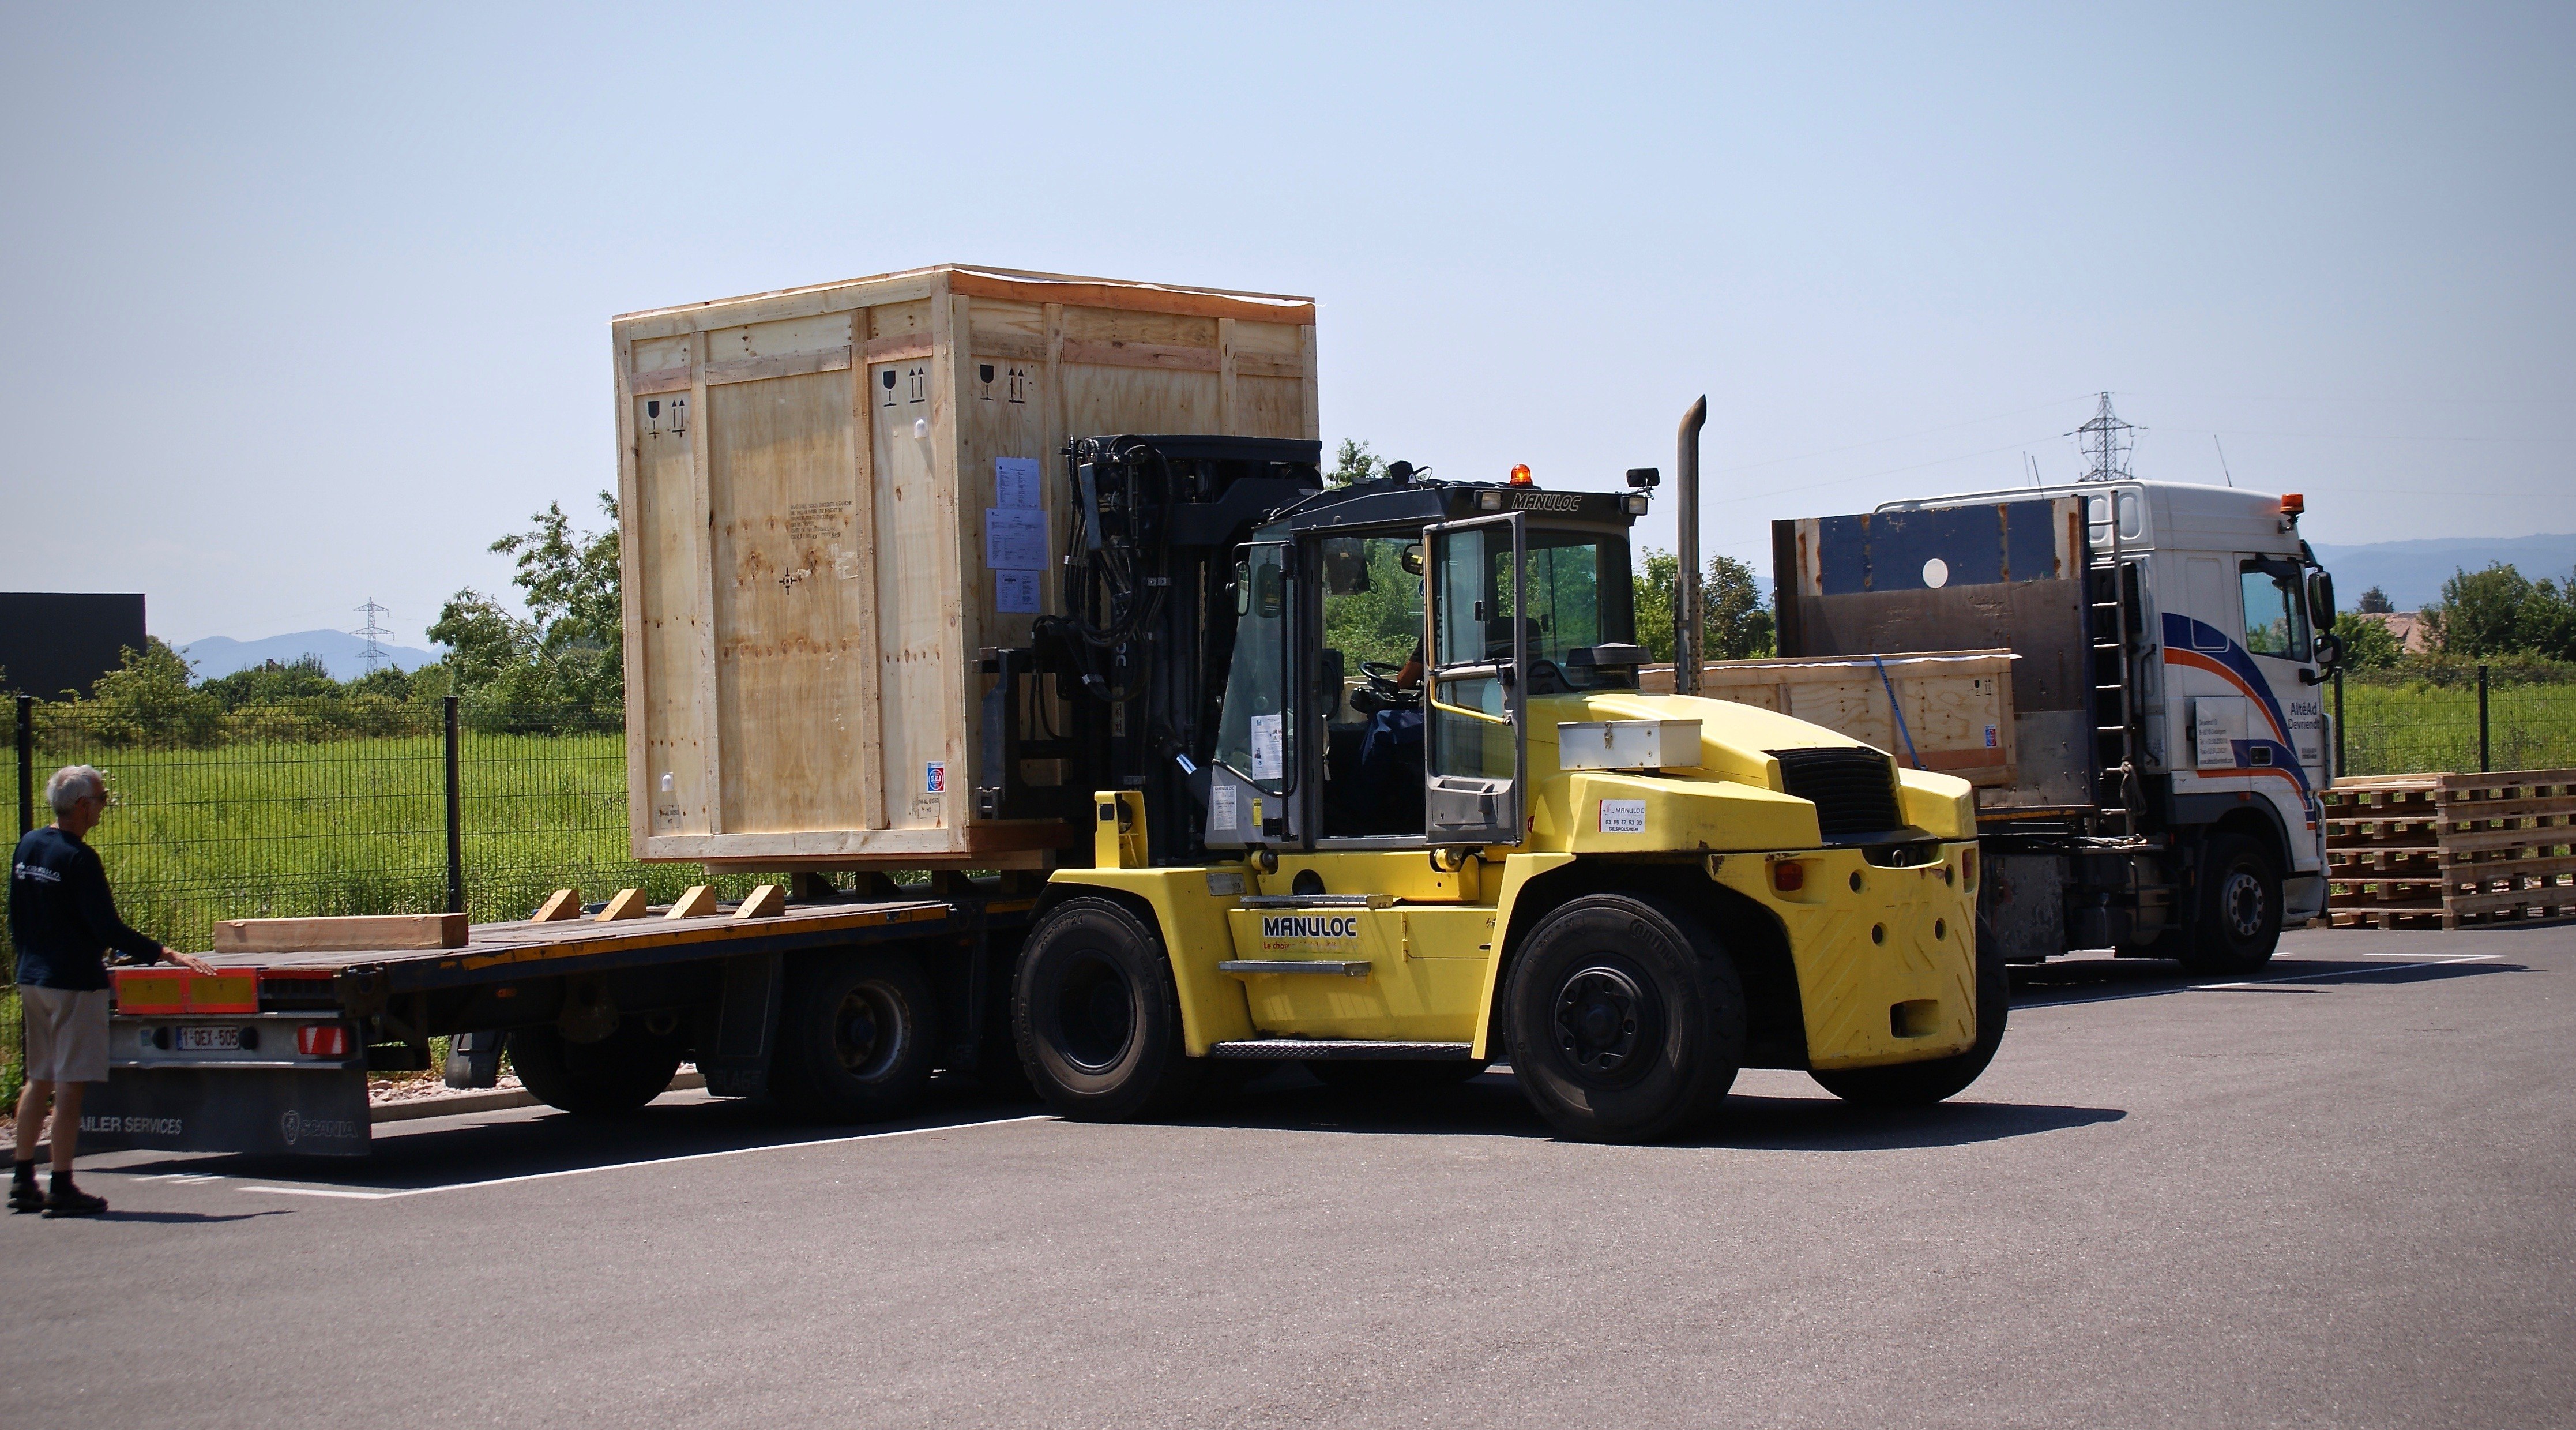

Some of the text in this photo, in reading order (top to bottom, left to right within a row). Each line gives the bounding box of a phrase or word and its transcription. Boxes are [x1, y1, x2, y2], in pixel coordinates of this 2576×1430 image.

[1511, 493, 1582, 512] MANULOC
[2291, 701, 2317, 715] AltéAd
[1263, 916, 1357, 937] MANULOC
[1263, 941, 1271, 949] Le
[80, 1116, 183, 1135] AILER SERVICES
[300, 1119, 358, 1138] SCANIA
